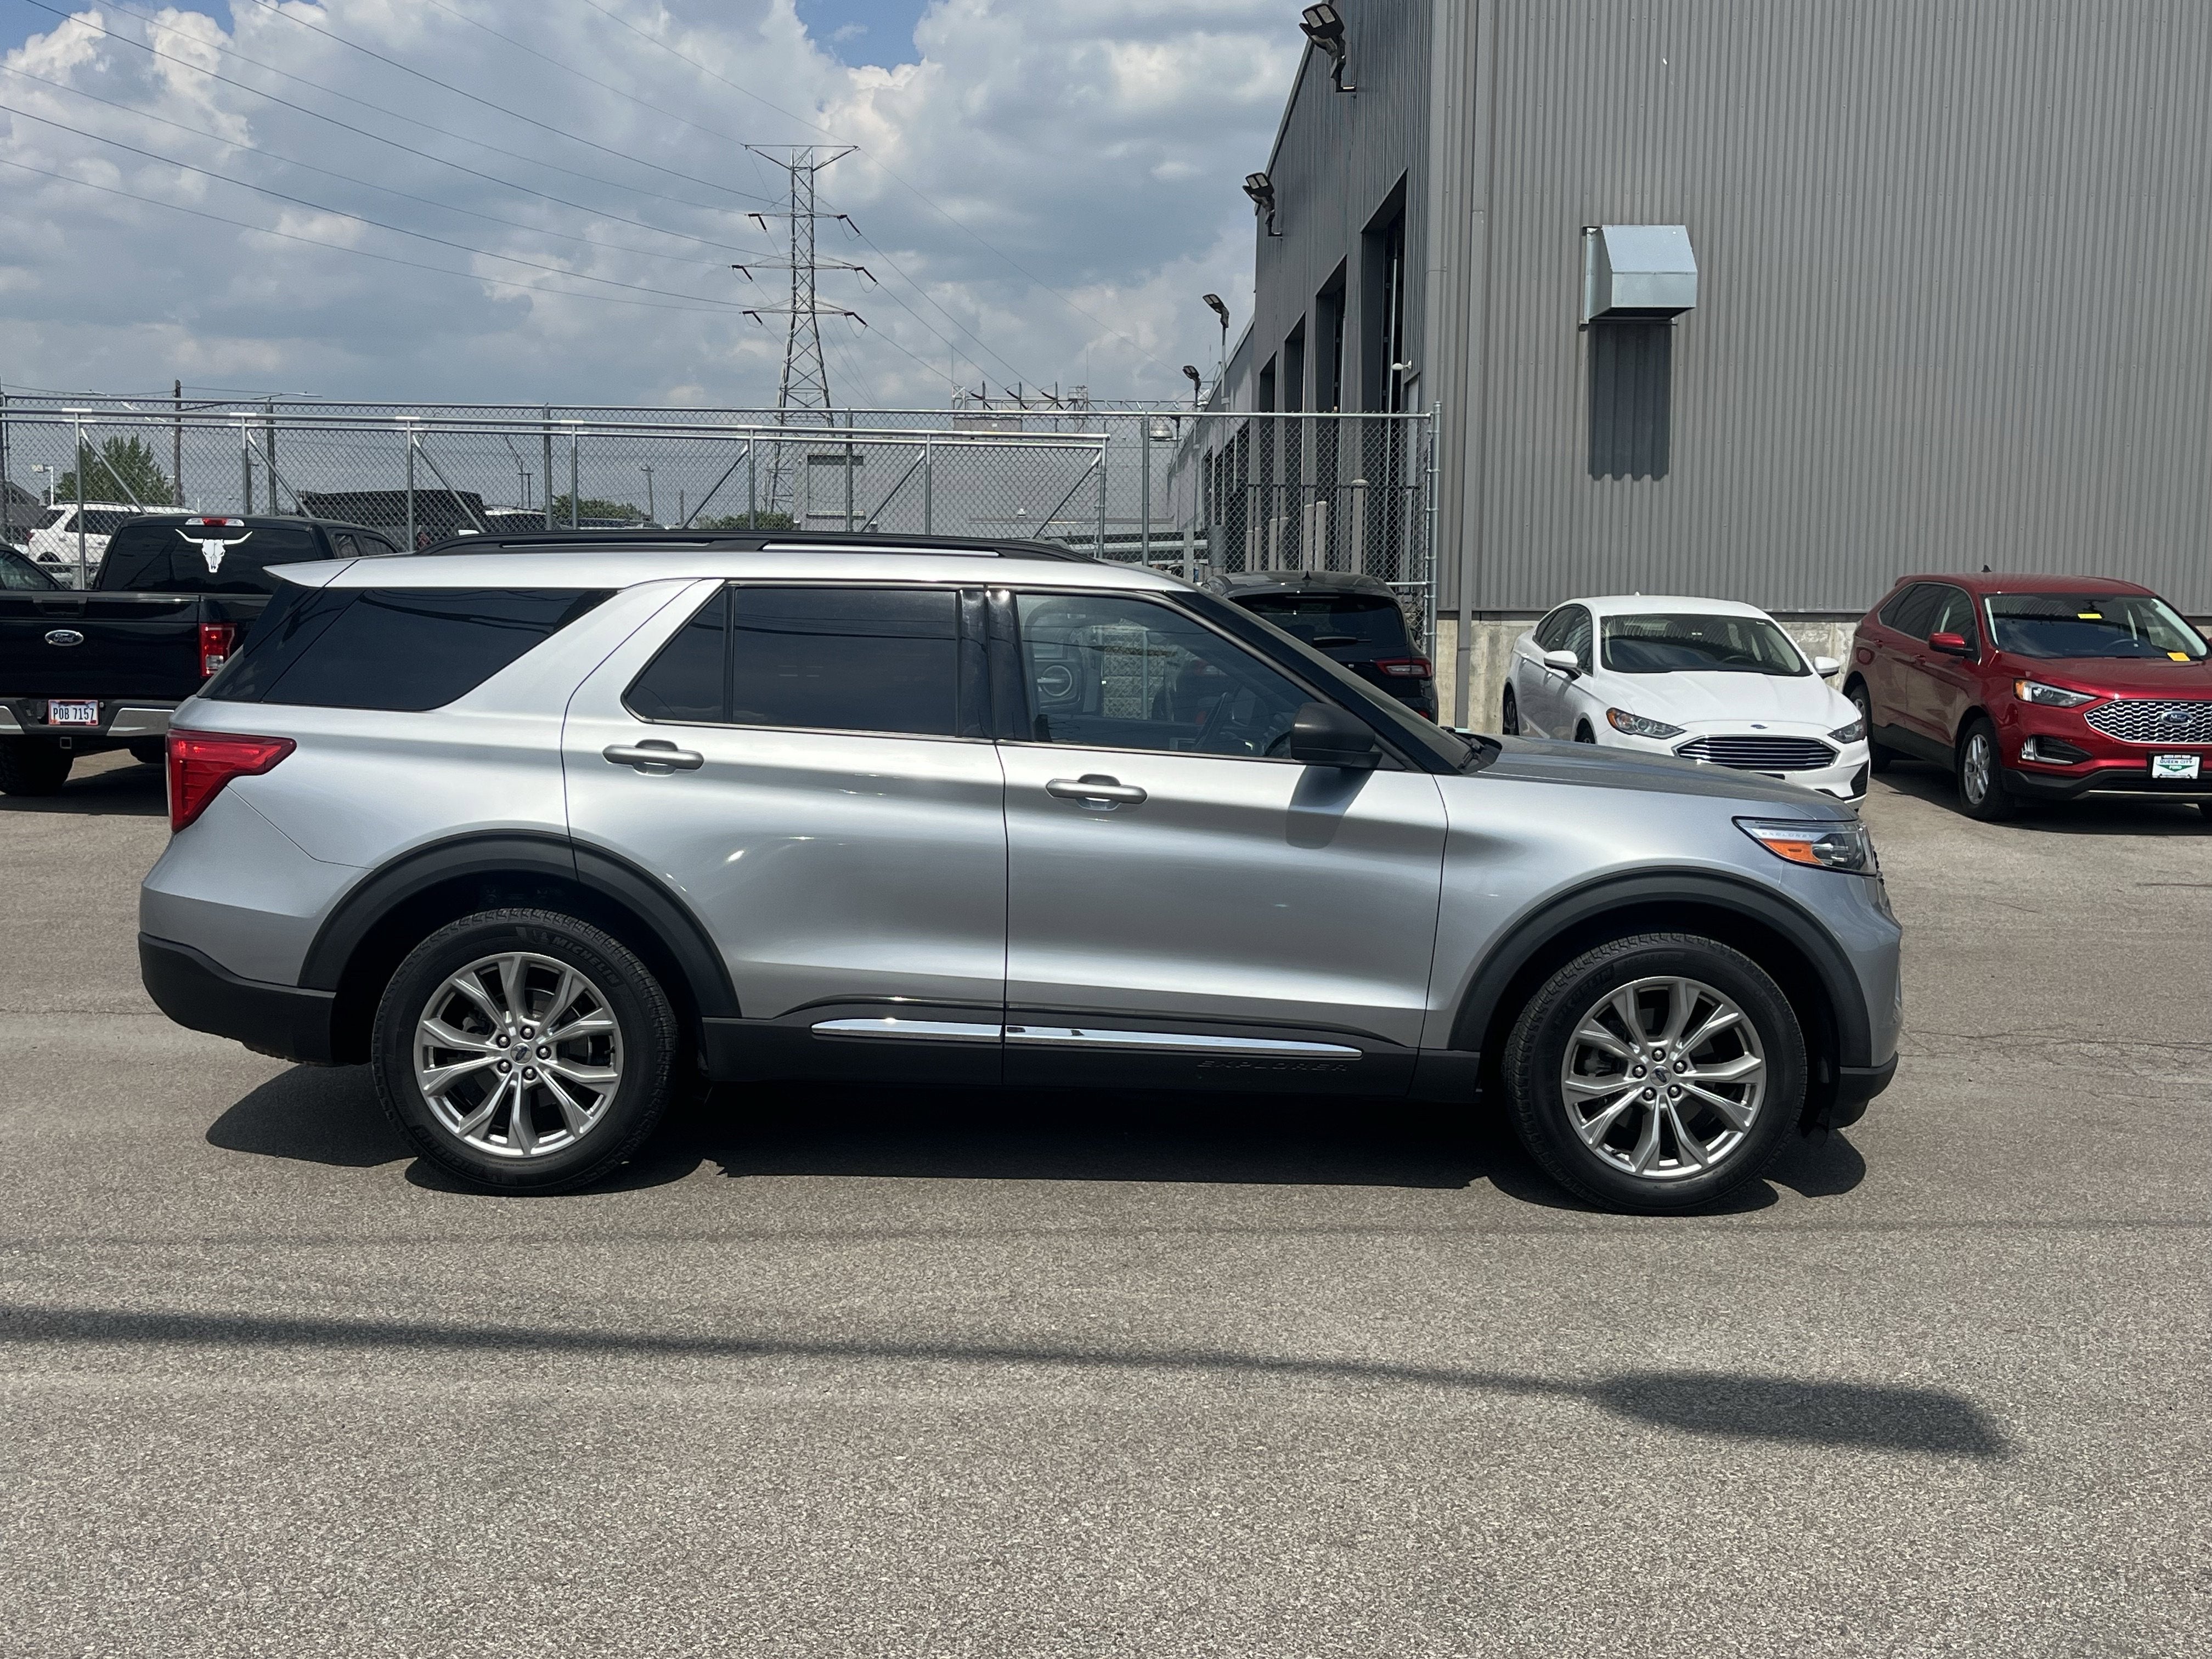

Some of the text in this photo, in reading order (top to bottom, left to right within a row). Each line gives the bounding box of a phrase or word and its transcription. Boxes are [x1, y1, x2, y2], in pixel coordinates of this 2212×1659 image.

[54, 633, 75, 642] Ford
[53, 707, 94, 720] POB 7157
[551, 935, 620, 984] MICHELIN
[1197, 1060, 1346, 1071] EXPLORER
